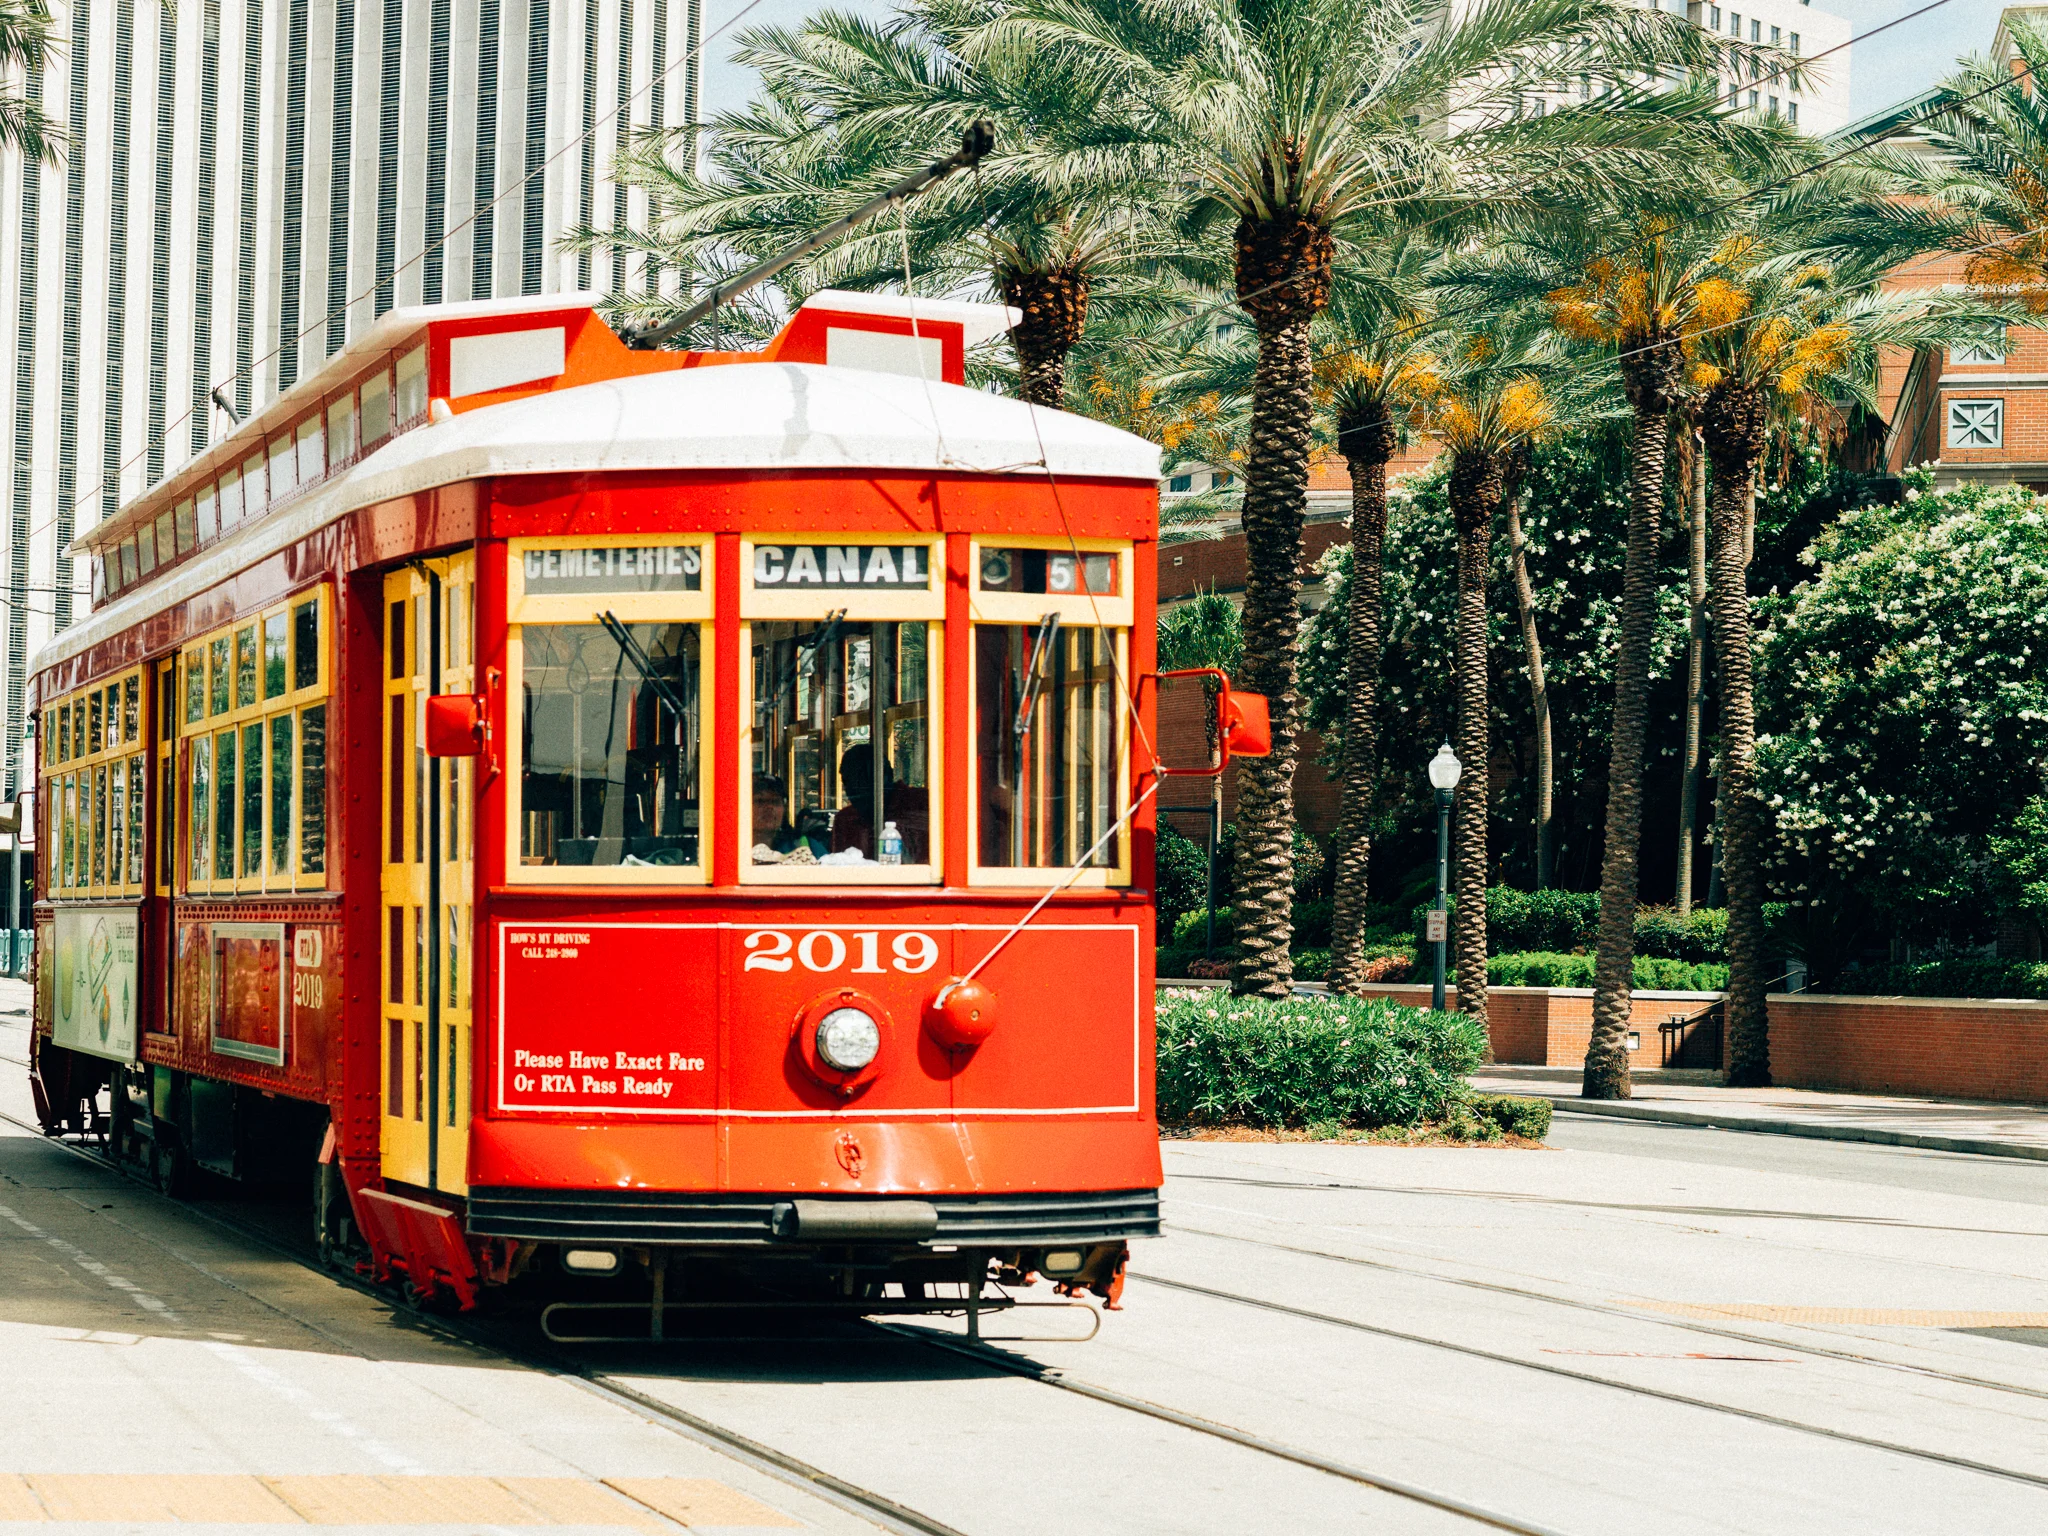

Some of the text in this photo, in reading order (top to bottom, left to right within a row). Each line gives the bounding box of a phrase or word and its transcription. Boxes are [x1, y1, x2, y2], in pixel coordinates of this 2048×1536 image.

[524, 546, 701, 579] CEMETERIES
[754, 546, 929, 583] CANAL
[1050, 557, 1071, 590] 5
[510, 932, 591, 945] HOW'S MY DRIVING
[522, 947, 544, 958] CALL
[744, 930, 939, 973] 2019
[294, 972, 322, 1009] 2019
[514, 1050, 705, 1071] Please Have Exact Fare
[514, 1074, 673, 1098] Or RTA Pass Ready
